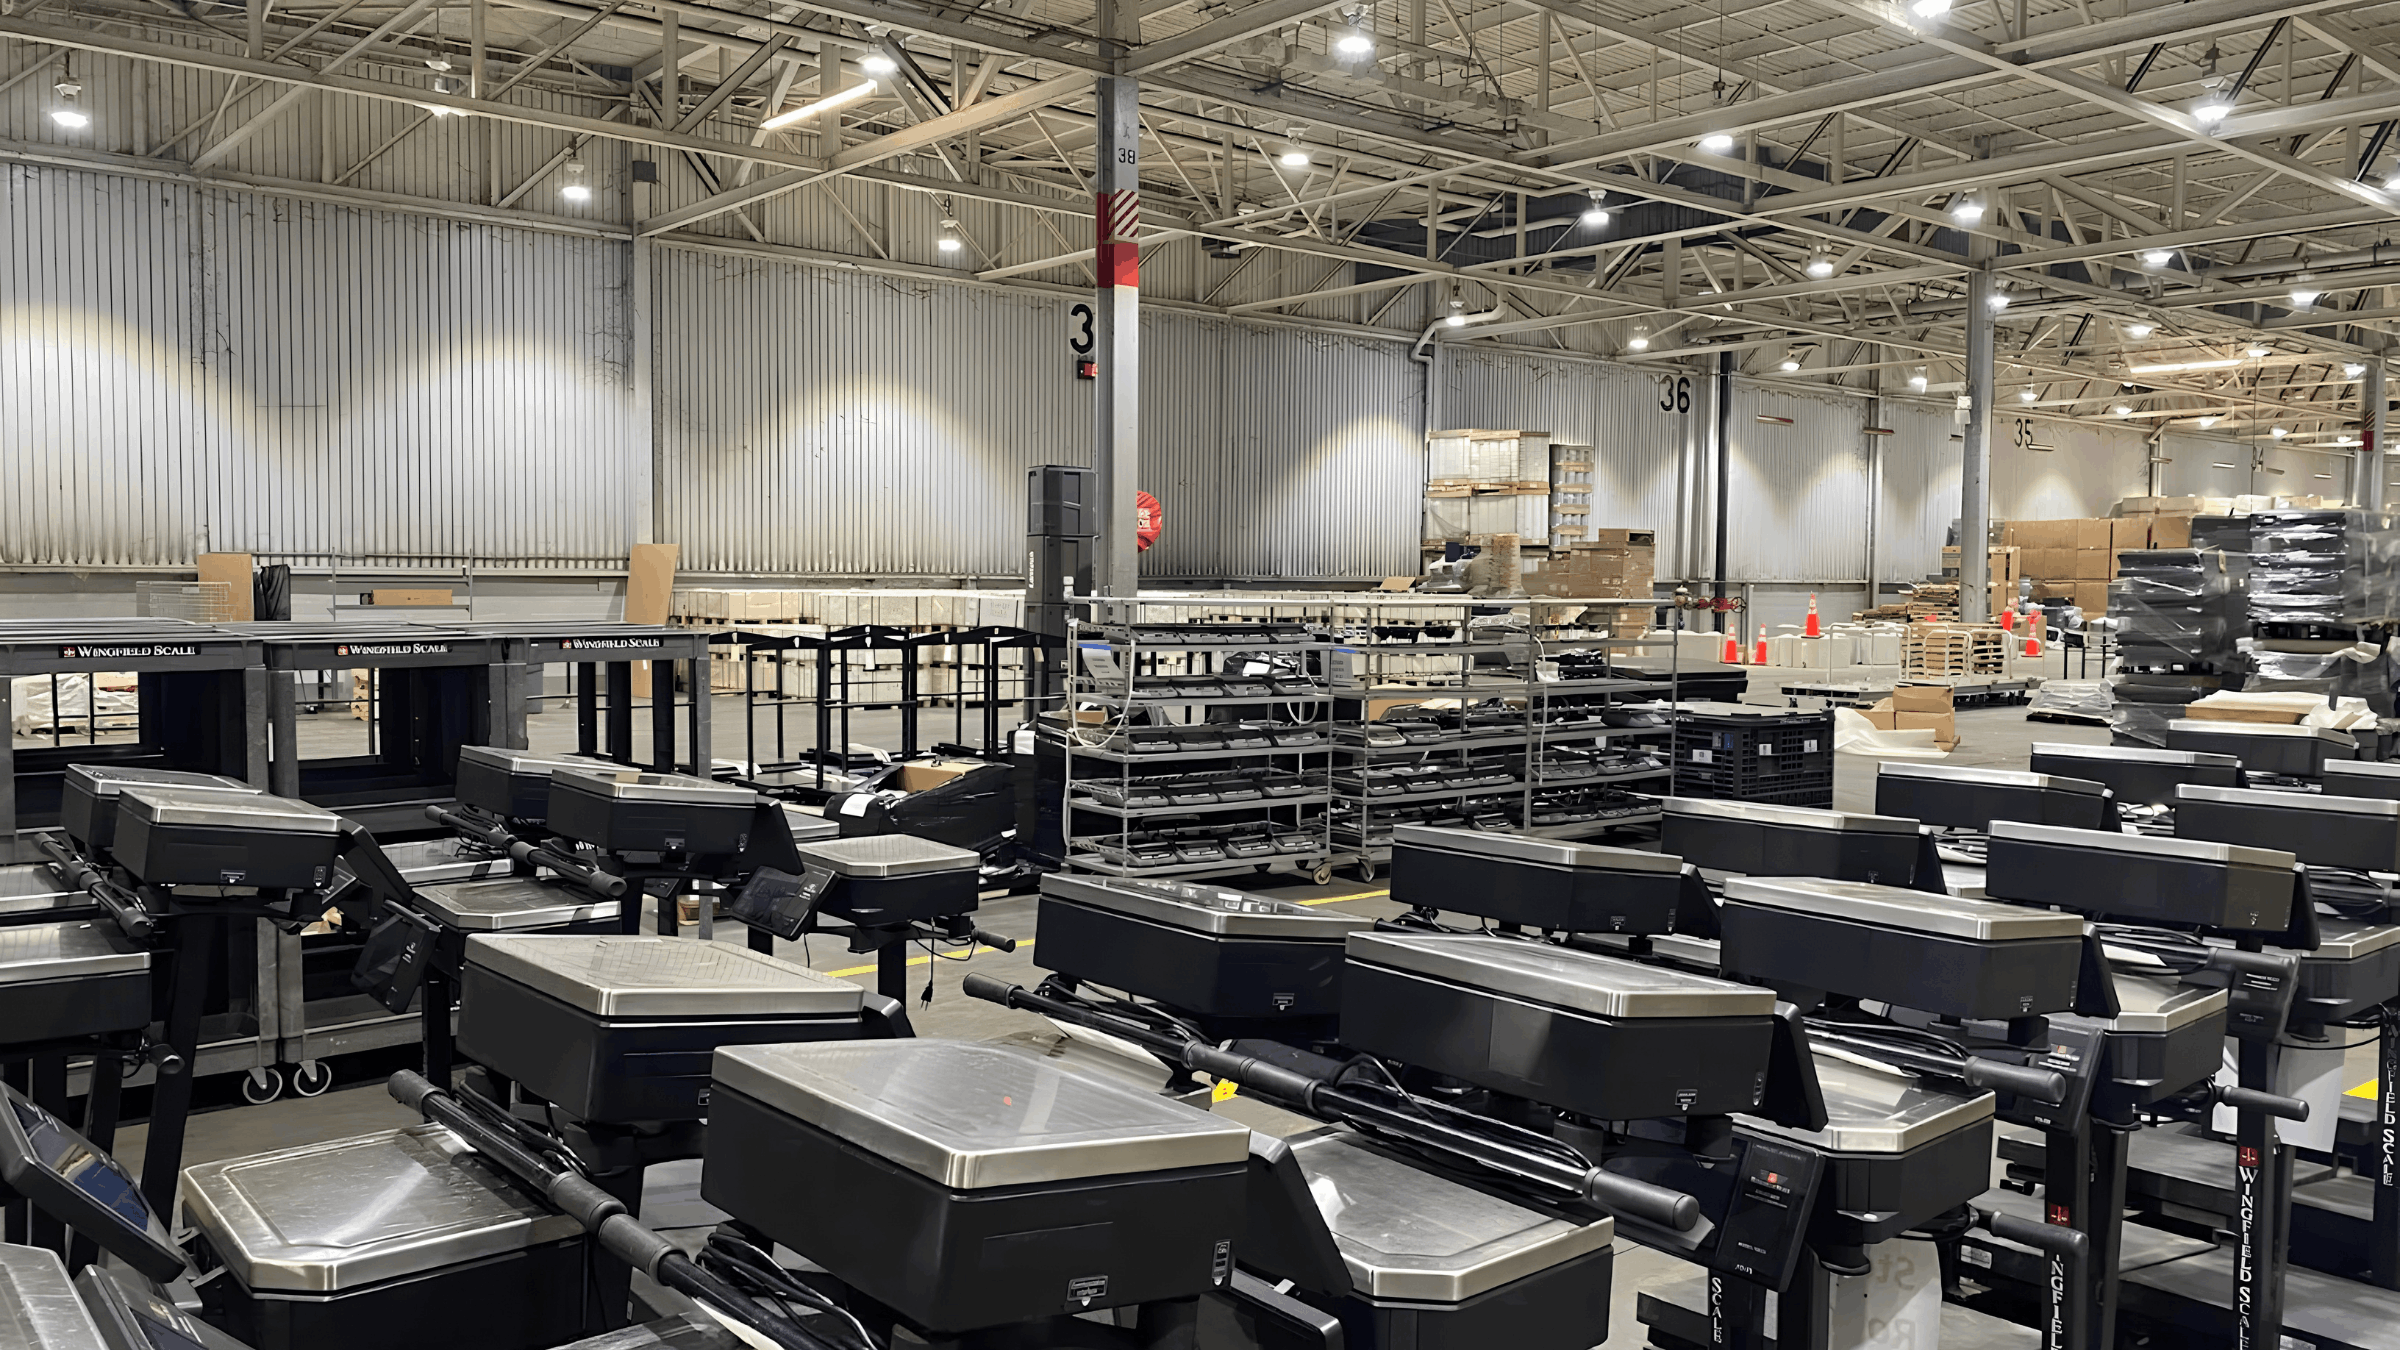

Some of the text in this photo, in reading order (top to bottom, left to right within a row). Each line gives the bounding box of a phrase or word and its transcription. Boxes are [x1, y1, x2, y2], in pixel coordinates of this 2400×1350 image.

[1118, 147, 1136, 165] 38
[1660, 374, 1691, 414] 36
[2013, 417, 2034, 450] 35
[77, 644, 196, 658] WINGFIELD SCALE
[2382, 1128, 2395, 1187] SCALE
[2238, 1165, 2259, 1350] WINGFIELD SCALE
[1711, 1276, 1723, 1344] SCALE
